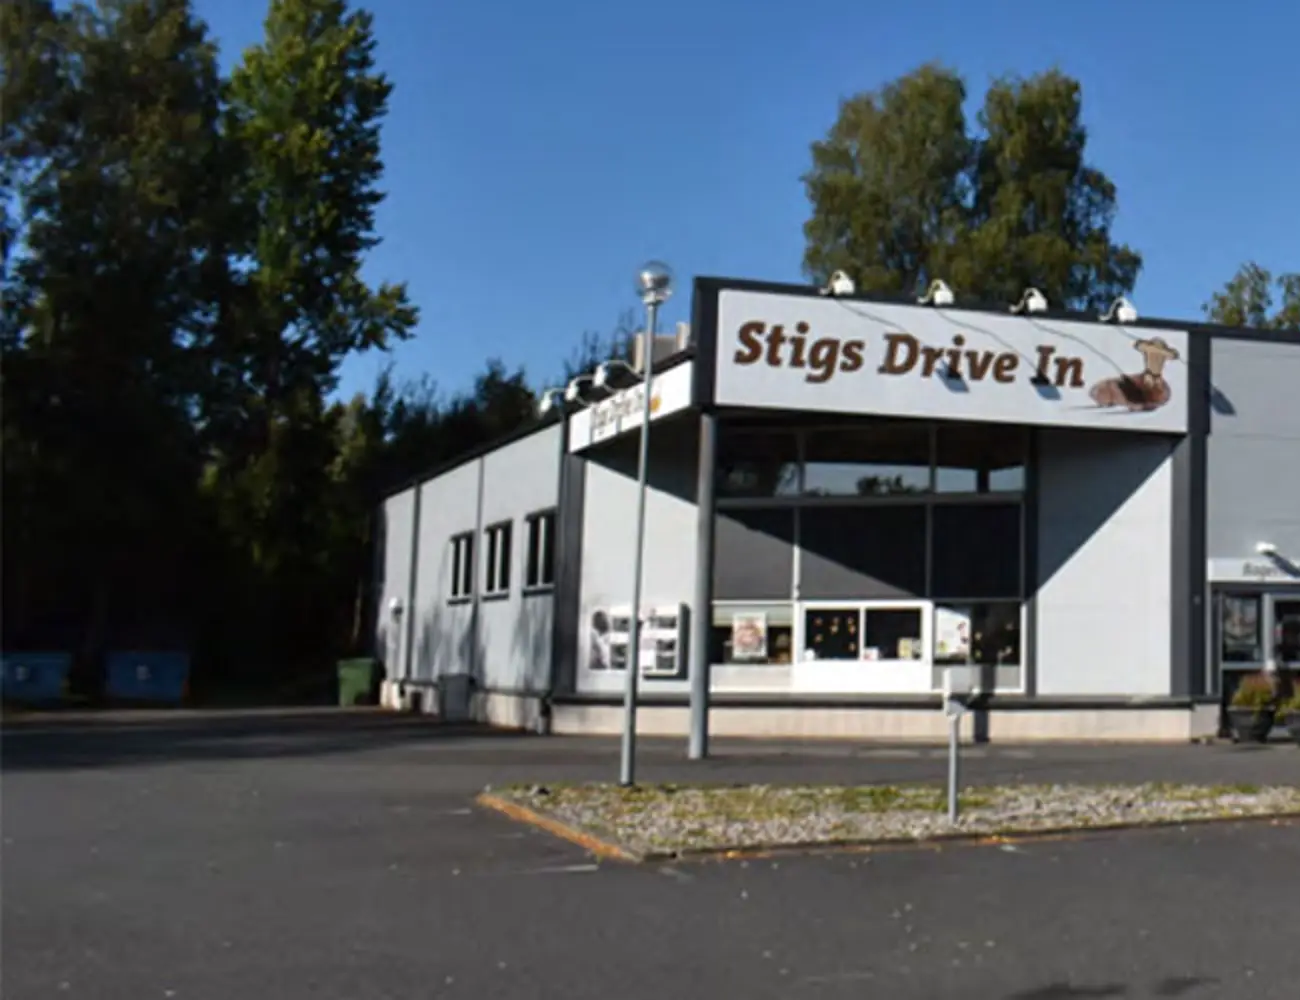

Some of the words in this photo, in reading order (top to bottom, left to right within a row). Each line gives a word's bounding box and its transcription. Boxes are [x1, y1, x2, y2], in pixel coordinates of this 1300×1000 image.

[734, 320, 865, 383] Stigs
[877, 331, 1019, 384] Drive
[1029, 344, 1086, 388] In
